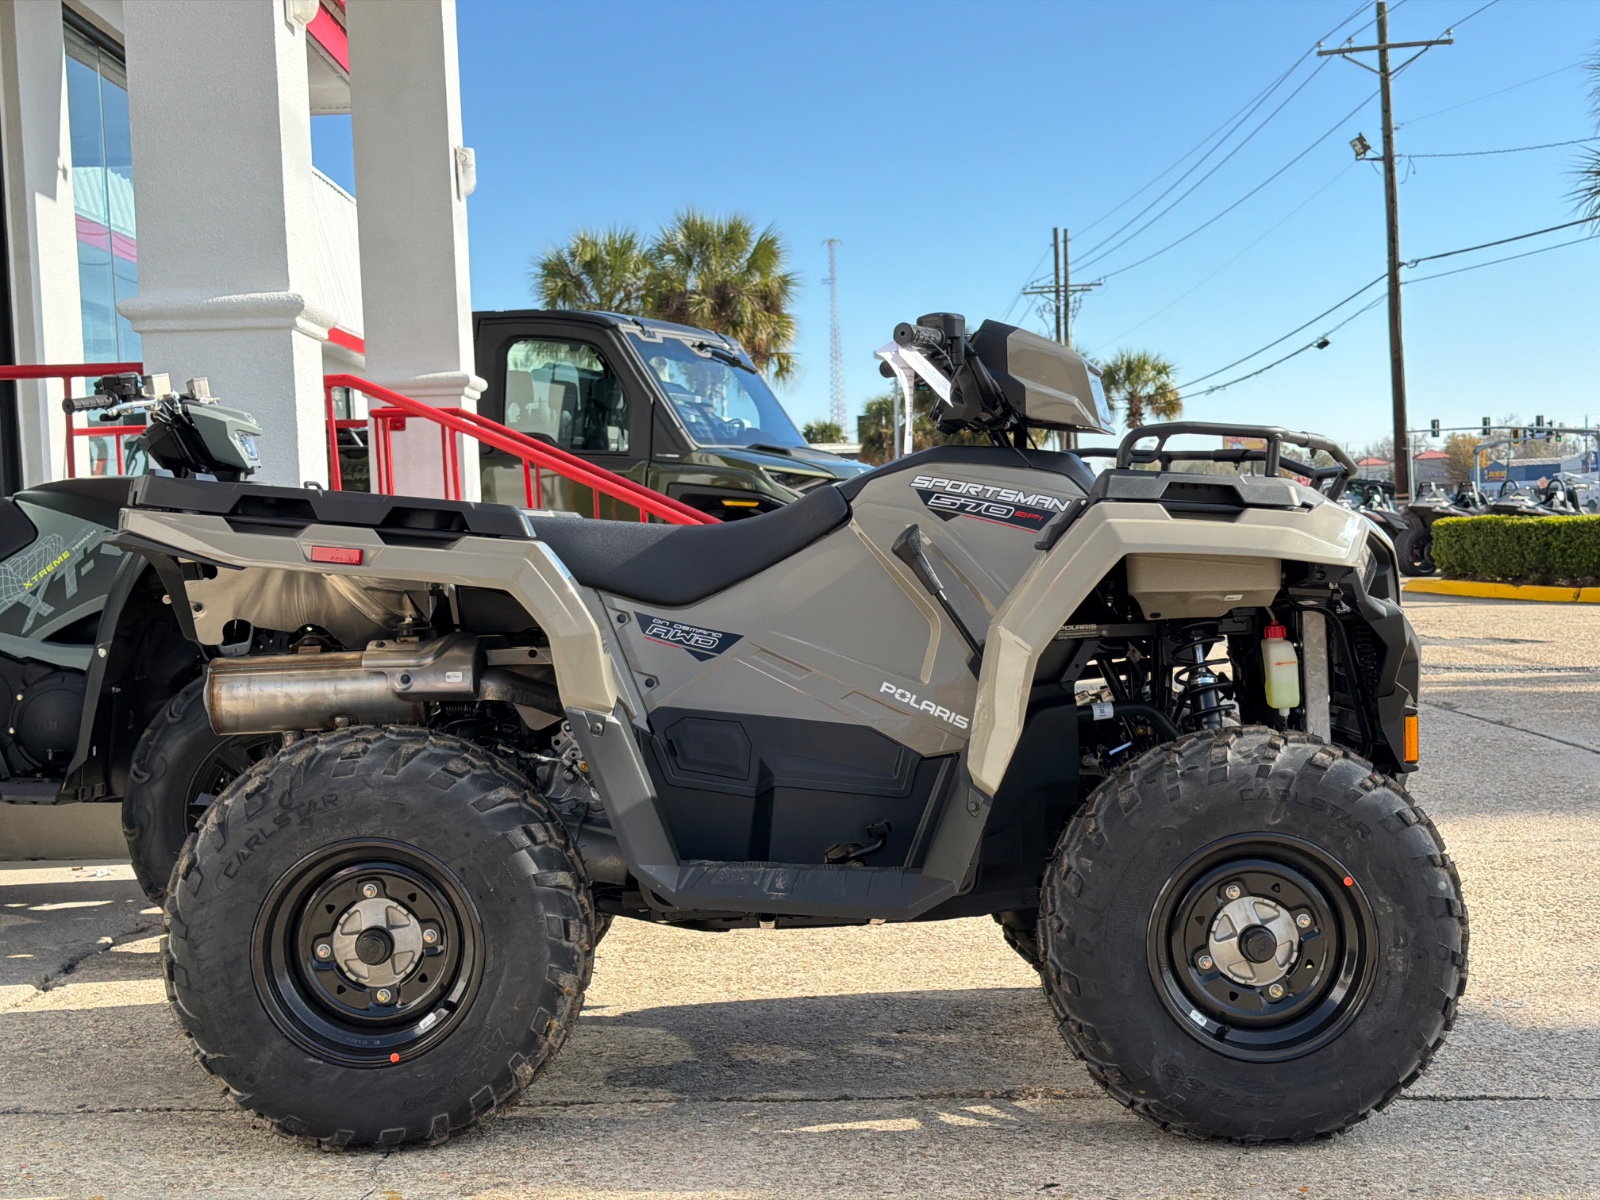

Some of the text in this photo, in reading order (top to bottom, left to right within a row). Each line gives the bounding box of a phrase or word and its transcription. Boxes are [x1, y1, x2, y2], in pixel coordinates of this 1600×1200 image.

[910, 475, 1072, 512] SPORTSMAN
[927, 493, 1016, 519] 570
[645, 623, 719, 649] AWD
[652, 618, 723, 638] ON DEMAND
[879, 681, 970, 730] POLARIS
[1239, 787, 1372, 839] CARLSTAR
[223, 793, 339, 879] CARLSTAR
